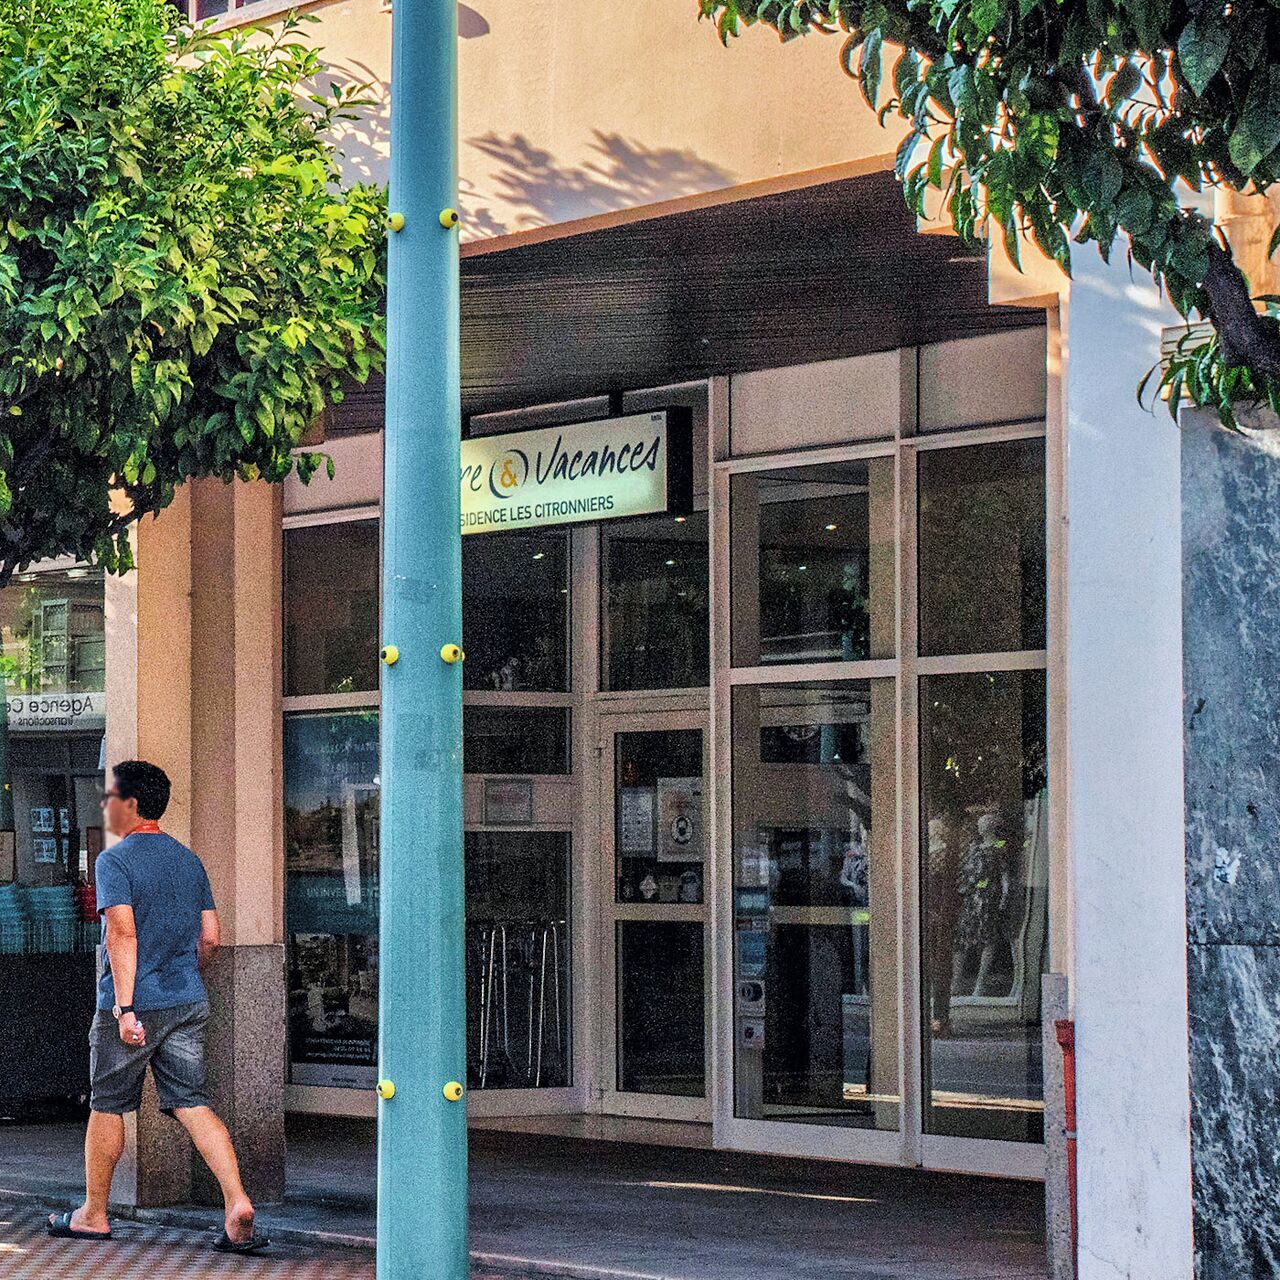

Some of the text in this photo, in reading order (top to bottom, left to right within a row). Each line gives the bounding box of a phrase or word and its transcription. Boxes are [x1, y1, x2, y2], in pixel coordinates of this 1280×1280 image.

[460, 464, 483, 492] re
[535, 435, 661, 486] Vacances
[509, 505, 532, 522] LES
[534, 495, 615, 519] CITRONNIERS
